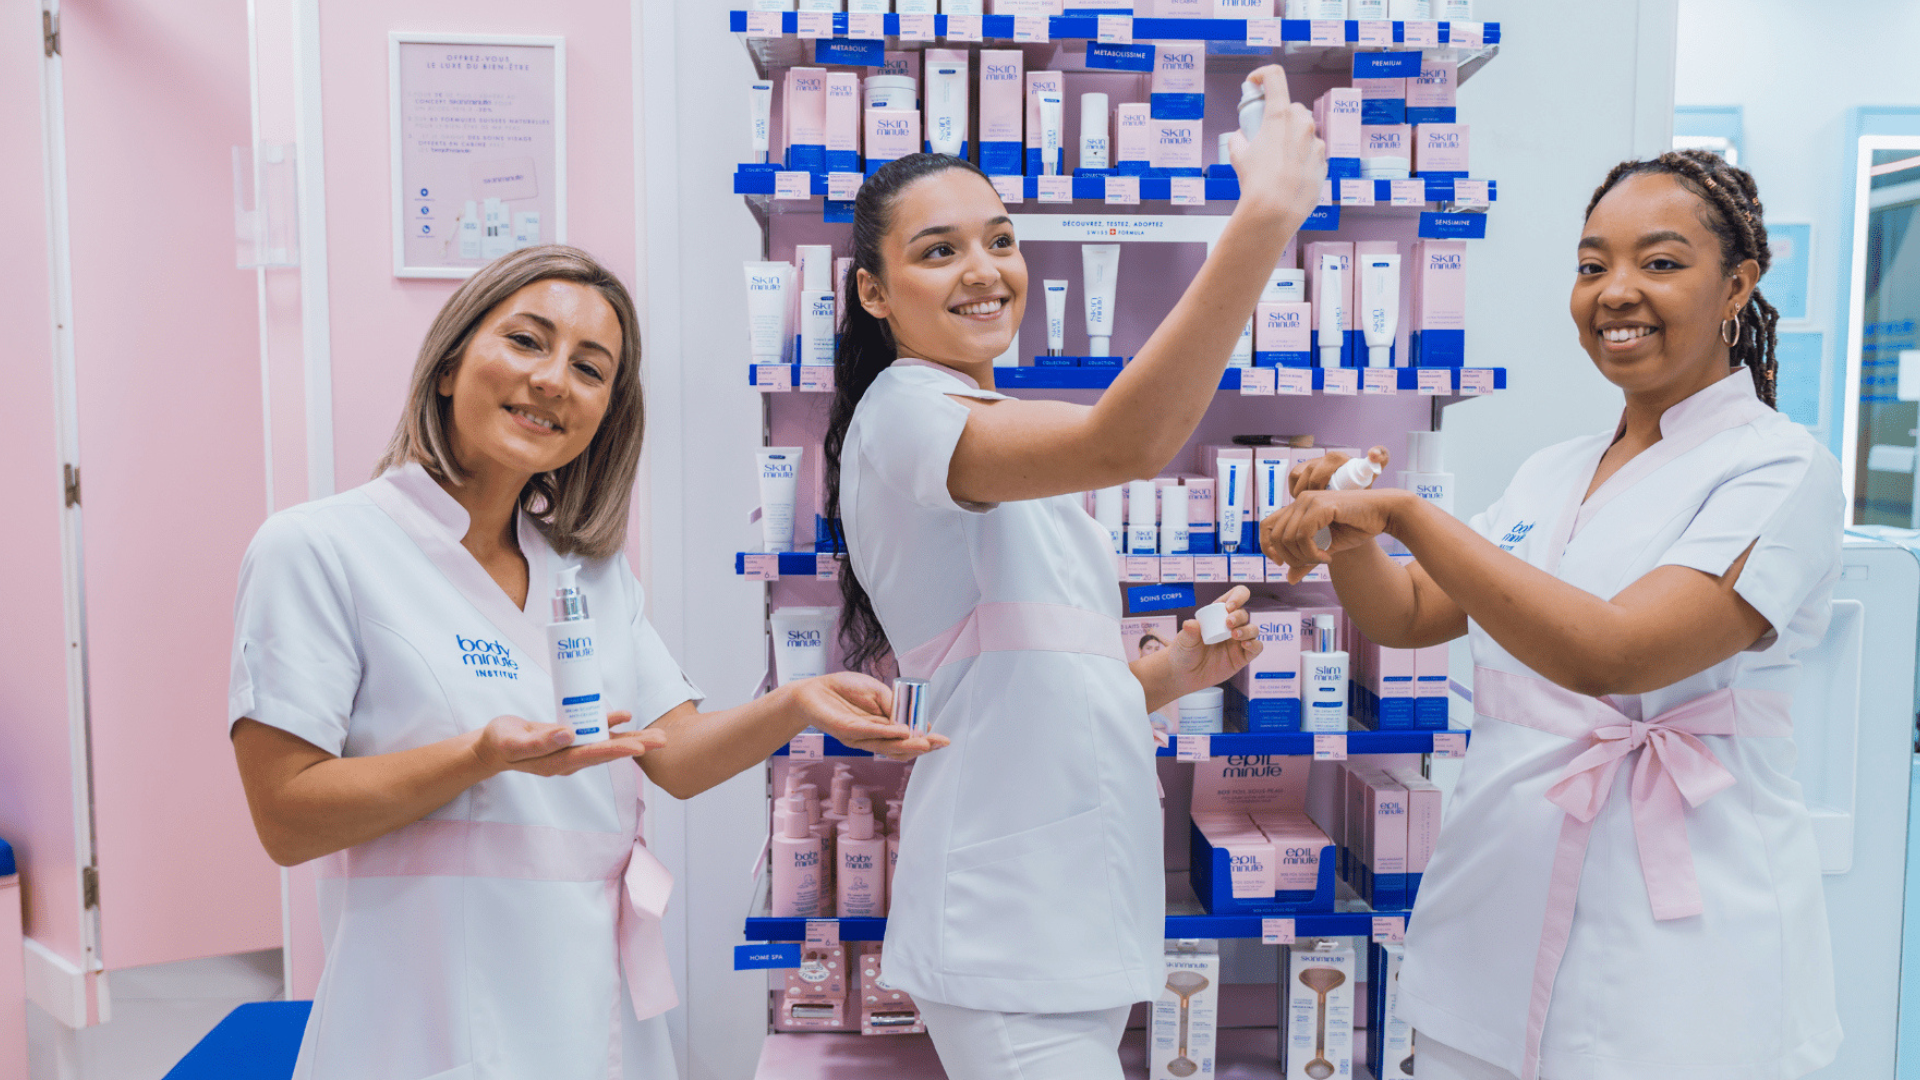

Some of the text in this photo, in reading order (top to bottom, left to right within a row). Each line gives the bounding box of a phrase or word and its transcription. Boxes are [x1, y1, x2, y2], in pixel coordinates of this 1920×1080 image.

[830, 44, 868, 53] METABOLIC
[1093, 49, 1146, 59] METABOLISSIME
[1140, 592, 1182, 603] SOINS CORPS
[455, 634, 511, 659] body
[557, 636, 592, 652] slim
[557, 648, 594, 661] minute
[462, 653, 519, 670] minute
[475, 669, 519, 681] INSTITUT
[1222, 766, 1282, 779] minute
[845, 852, 873, 862] baby
[1283, 856, 1318, 865] minute
[845, 861, 873, 869] minute
[749, 954, 770, 962] HOME
